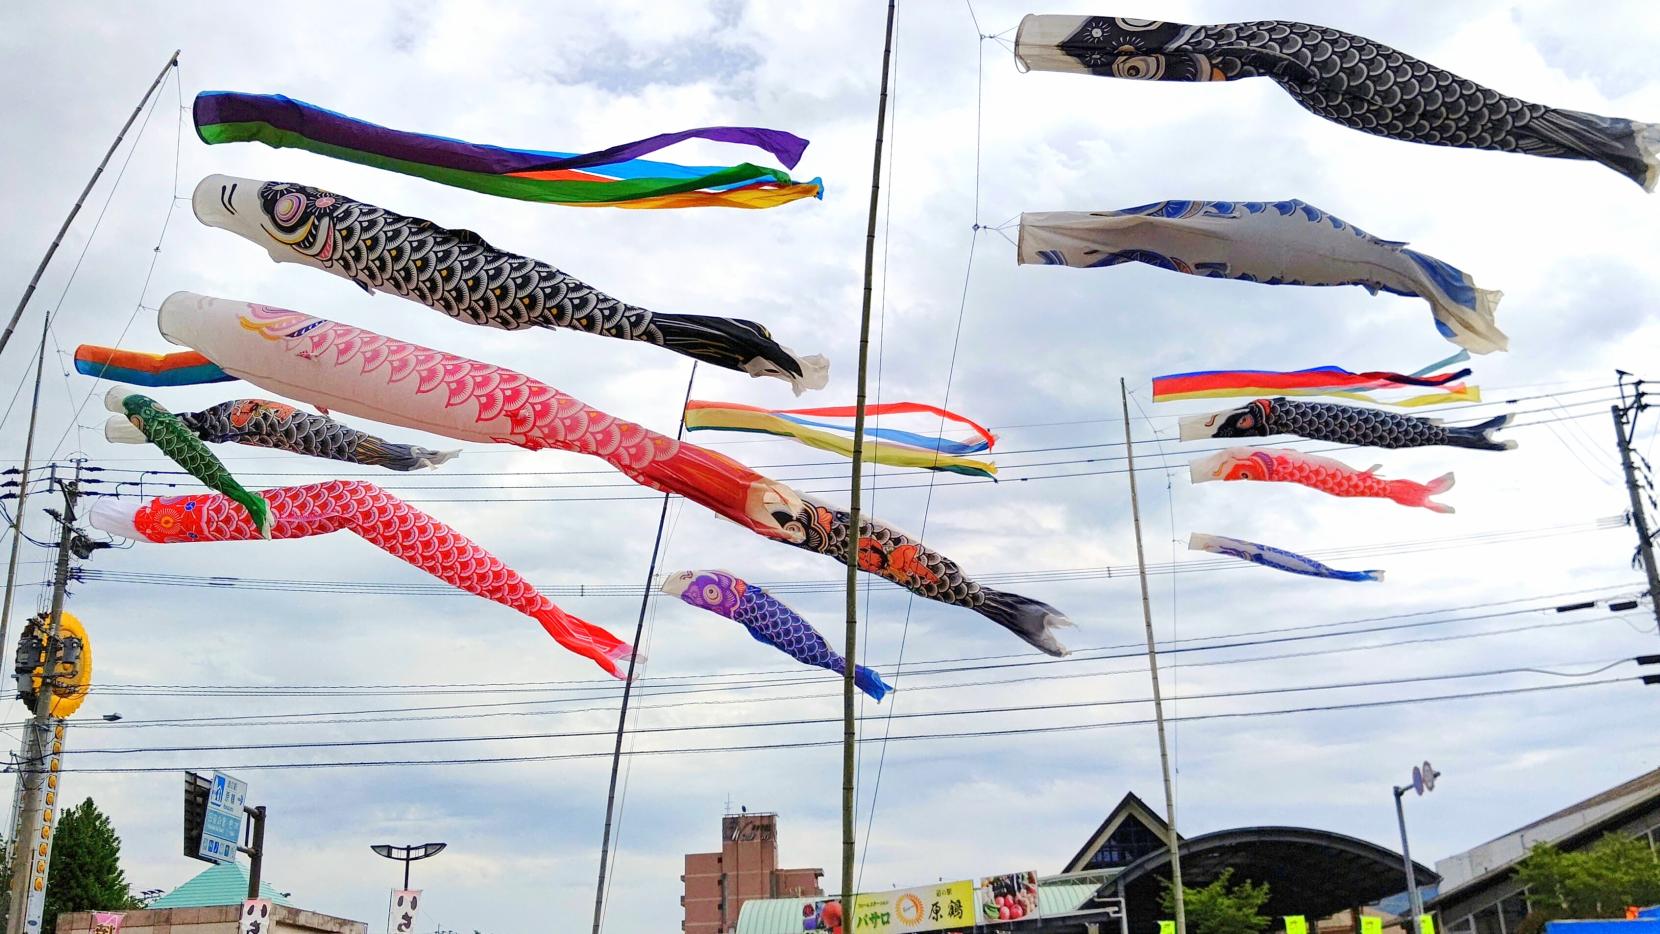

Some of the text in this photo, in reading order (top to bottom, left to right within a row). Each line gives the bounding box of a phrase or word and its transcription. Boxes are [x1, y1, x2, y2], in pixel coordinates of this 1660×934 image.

[857, 911, 891, 929] バサロ
[928, 899, 963, 921] 原鶴
